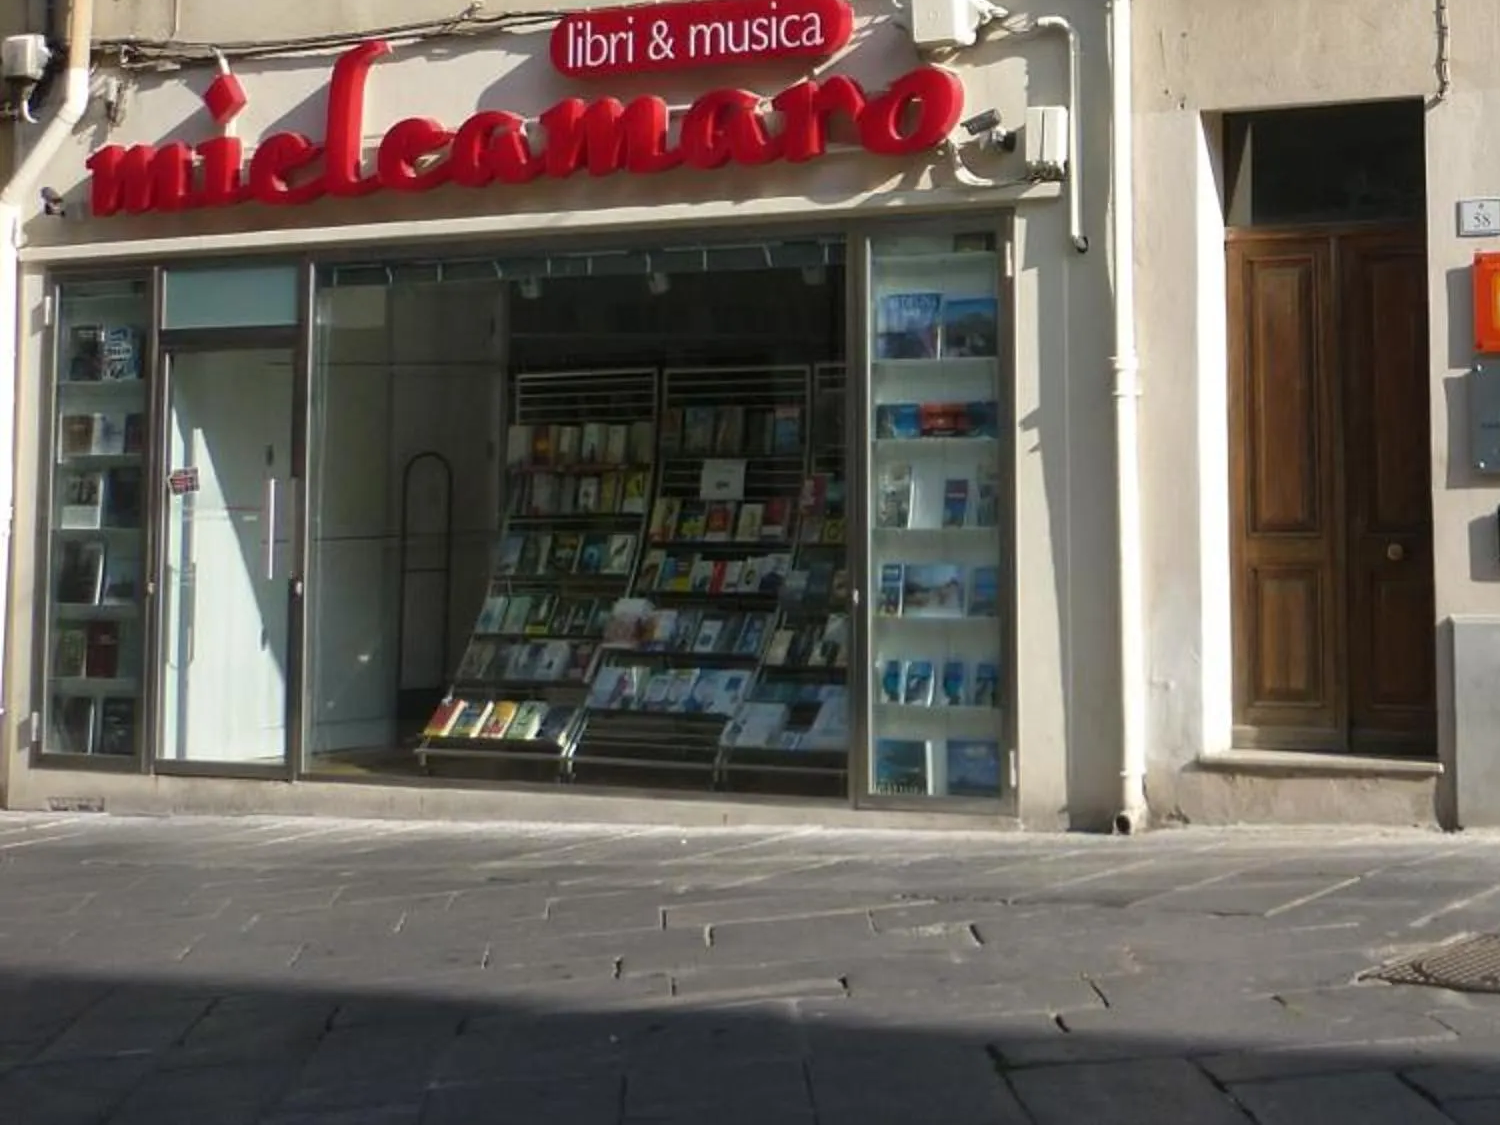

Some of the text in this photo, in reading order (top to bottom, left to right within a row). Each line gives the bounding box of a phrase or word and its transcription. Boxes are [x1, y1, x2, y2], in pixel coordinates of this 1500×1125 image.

[567, 1, 825, 69] libri & musica
